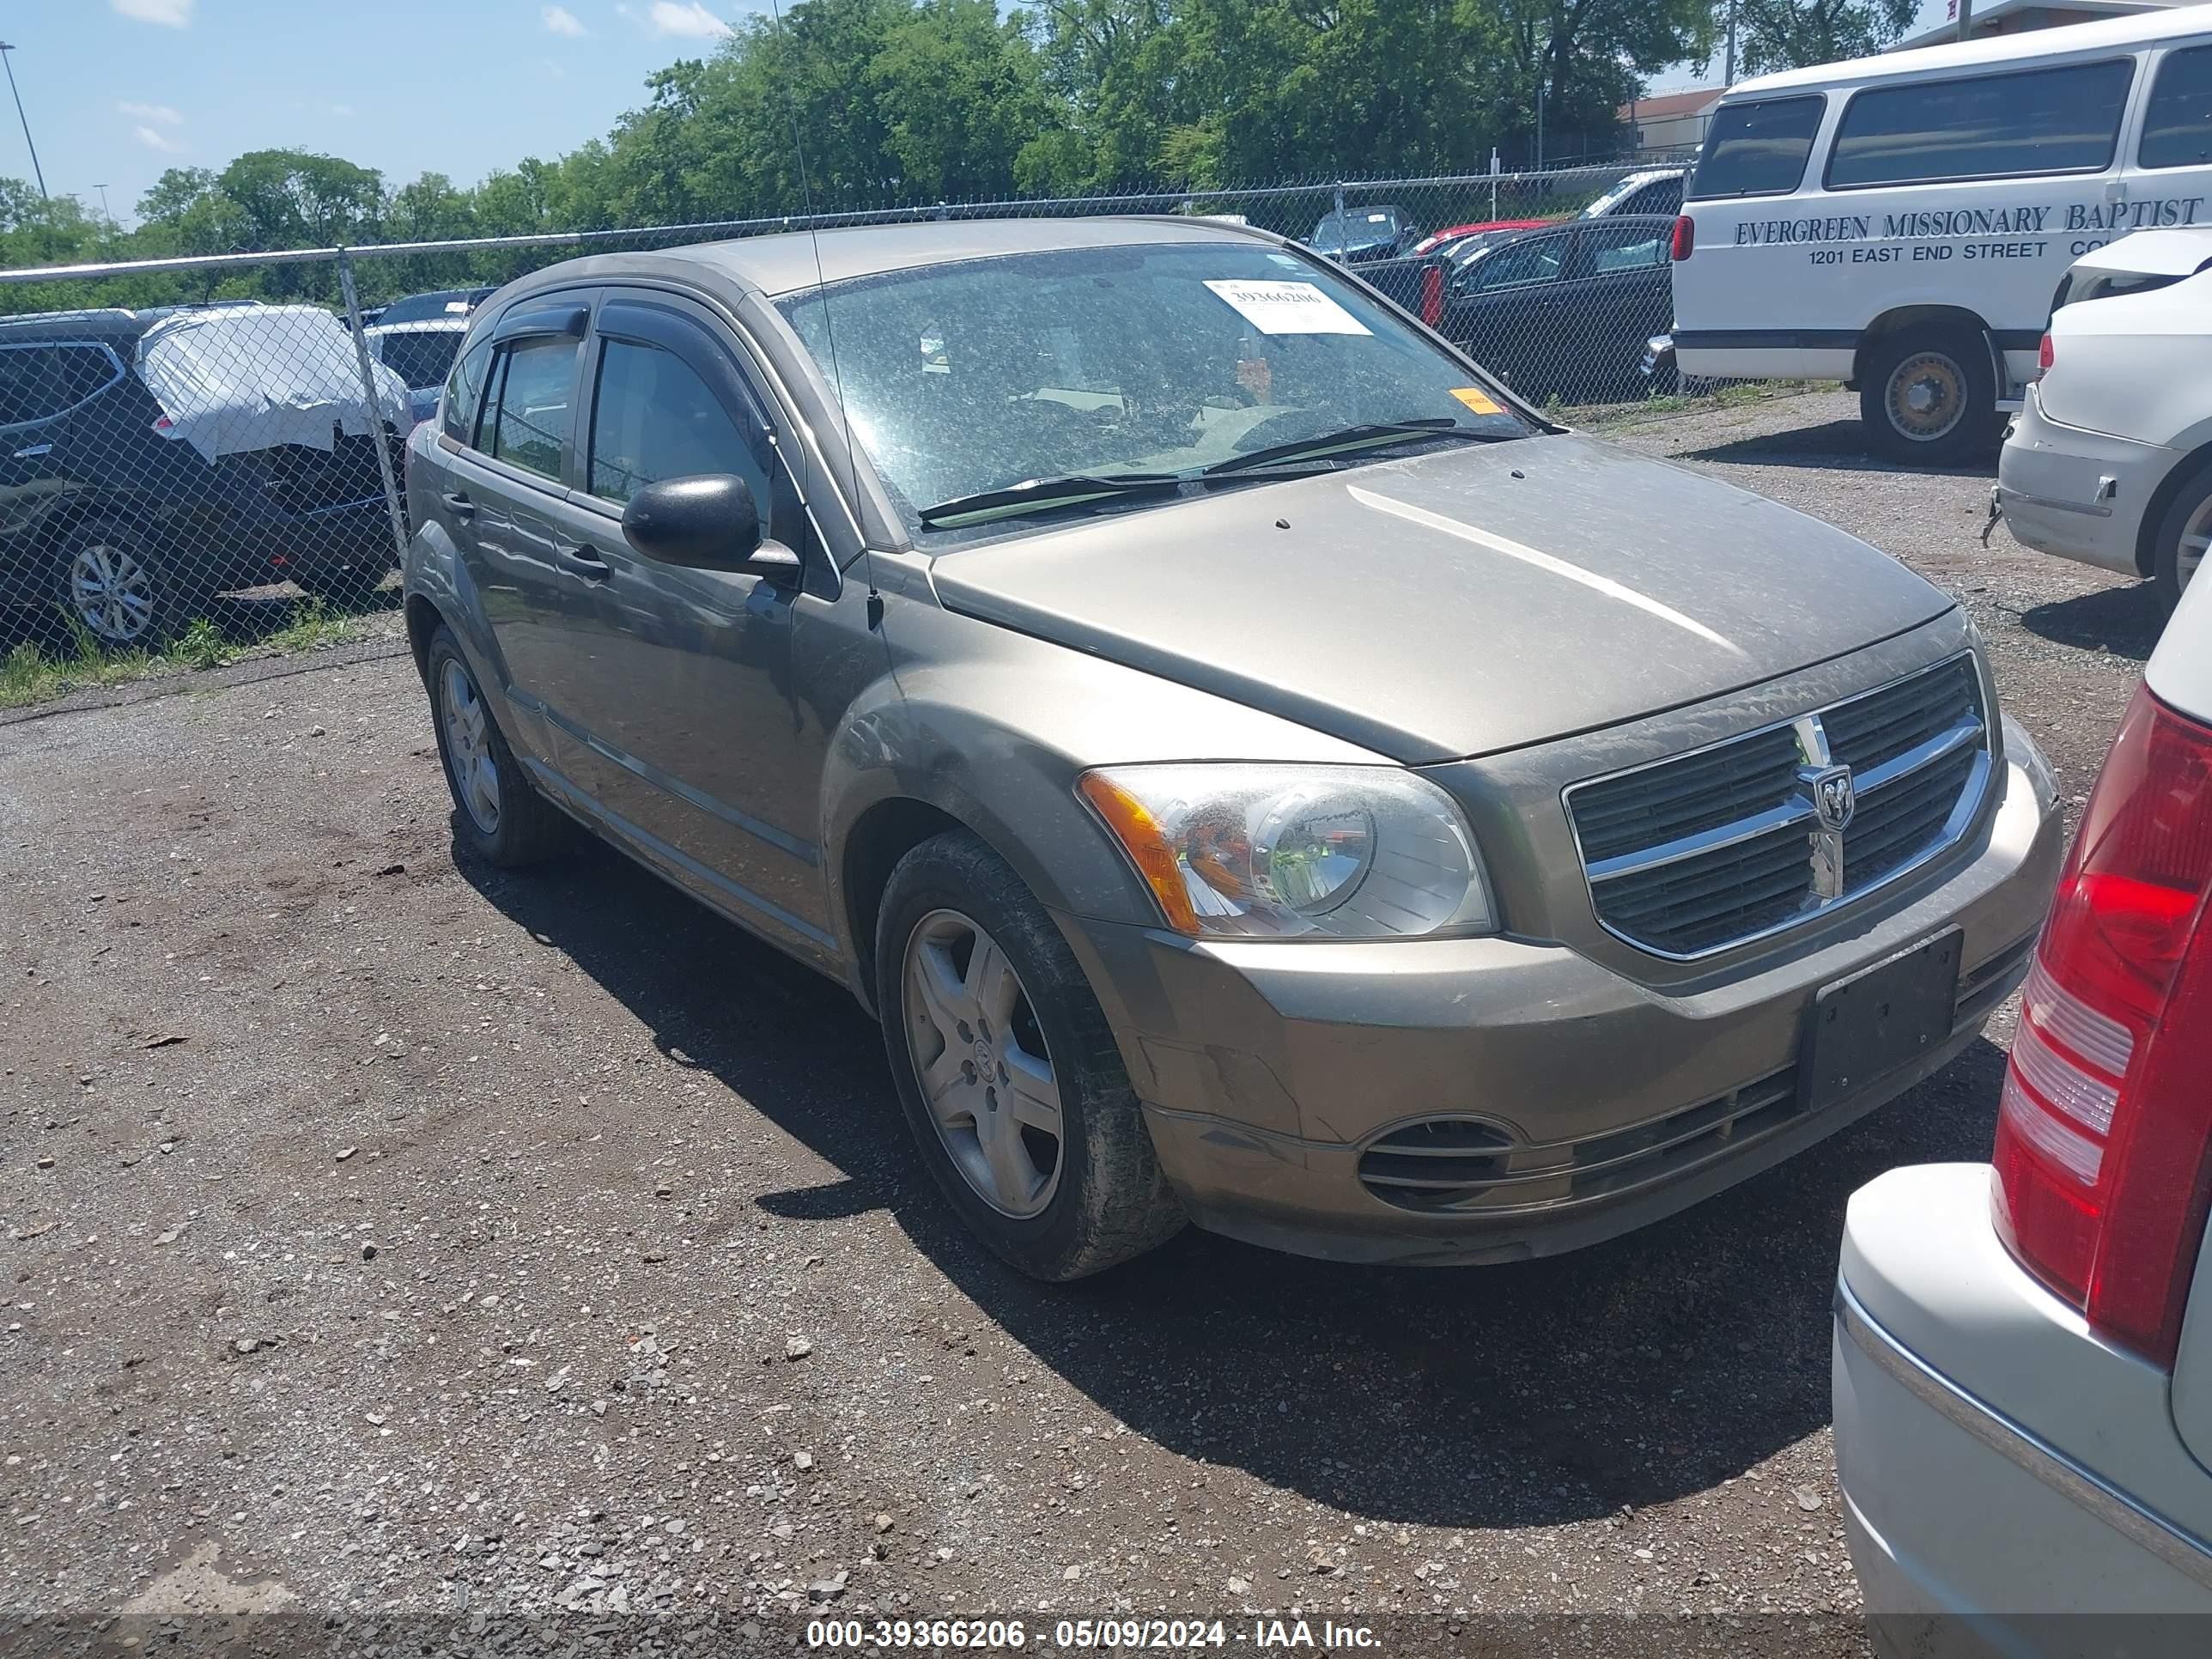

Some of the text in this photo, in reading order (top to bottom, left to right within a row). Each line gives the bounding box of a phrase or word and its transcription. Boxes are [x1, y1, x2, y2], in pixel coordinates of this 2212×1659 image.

[1735, 197, 2204, 246] EVERGREEN MISSIONARY BAPTIST
[1809, 240, 2110, 264] 1201 EAST END STREET CO
[1231, 292, 1322, 303] 39366206
